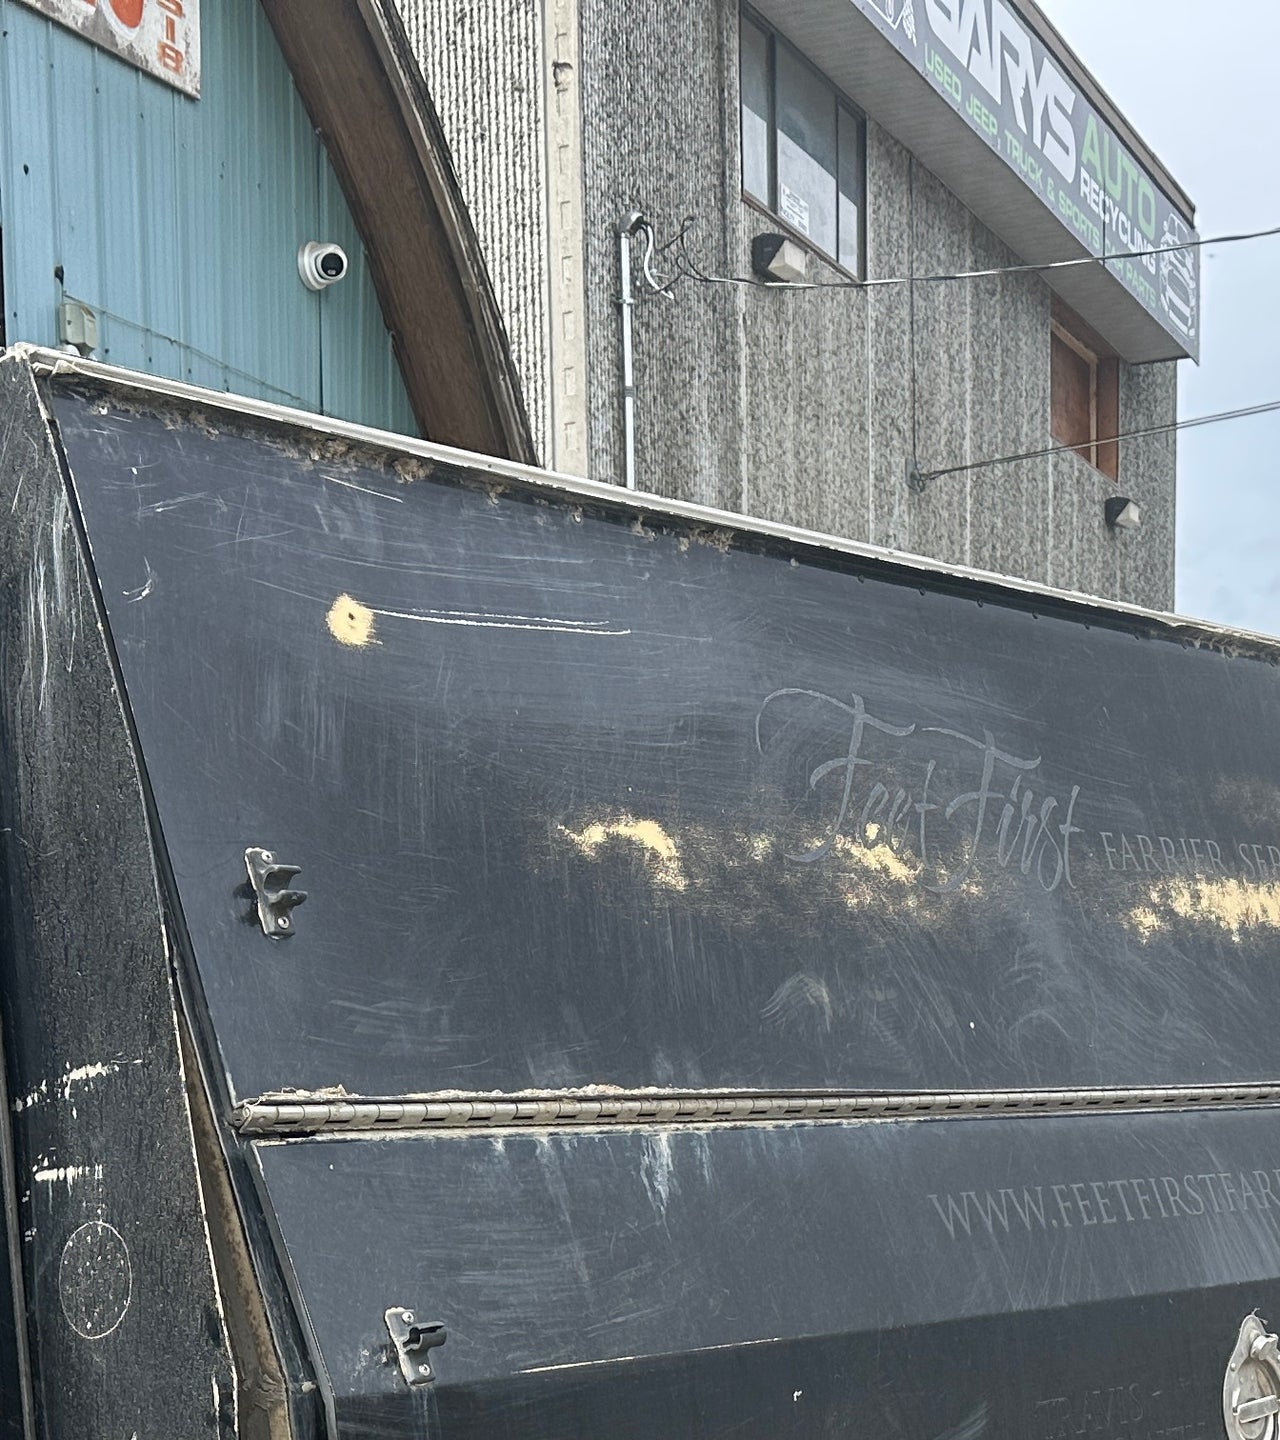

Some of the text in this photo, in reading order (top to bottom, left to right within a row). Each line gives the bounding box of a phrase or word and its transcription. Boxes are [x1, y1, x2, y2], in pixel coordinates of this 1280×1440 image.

[923, 42, 962, 103] USED
[1004, 129, 1043, 195] TRUCK
[1046, 181, 1056, 206] &
[1058, 190, 1100, 250] SPORTS
[1126, 261, 1157, 309] PARTS
[1079, 167, 1157, 276] RECYCLING
[1080, 113, 1156, 241] AUTO
[922, 727, 1086, 894] First
[1099, 830, 1231, 874] FARRIER
